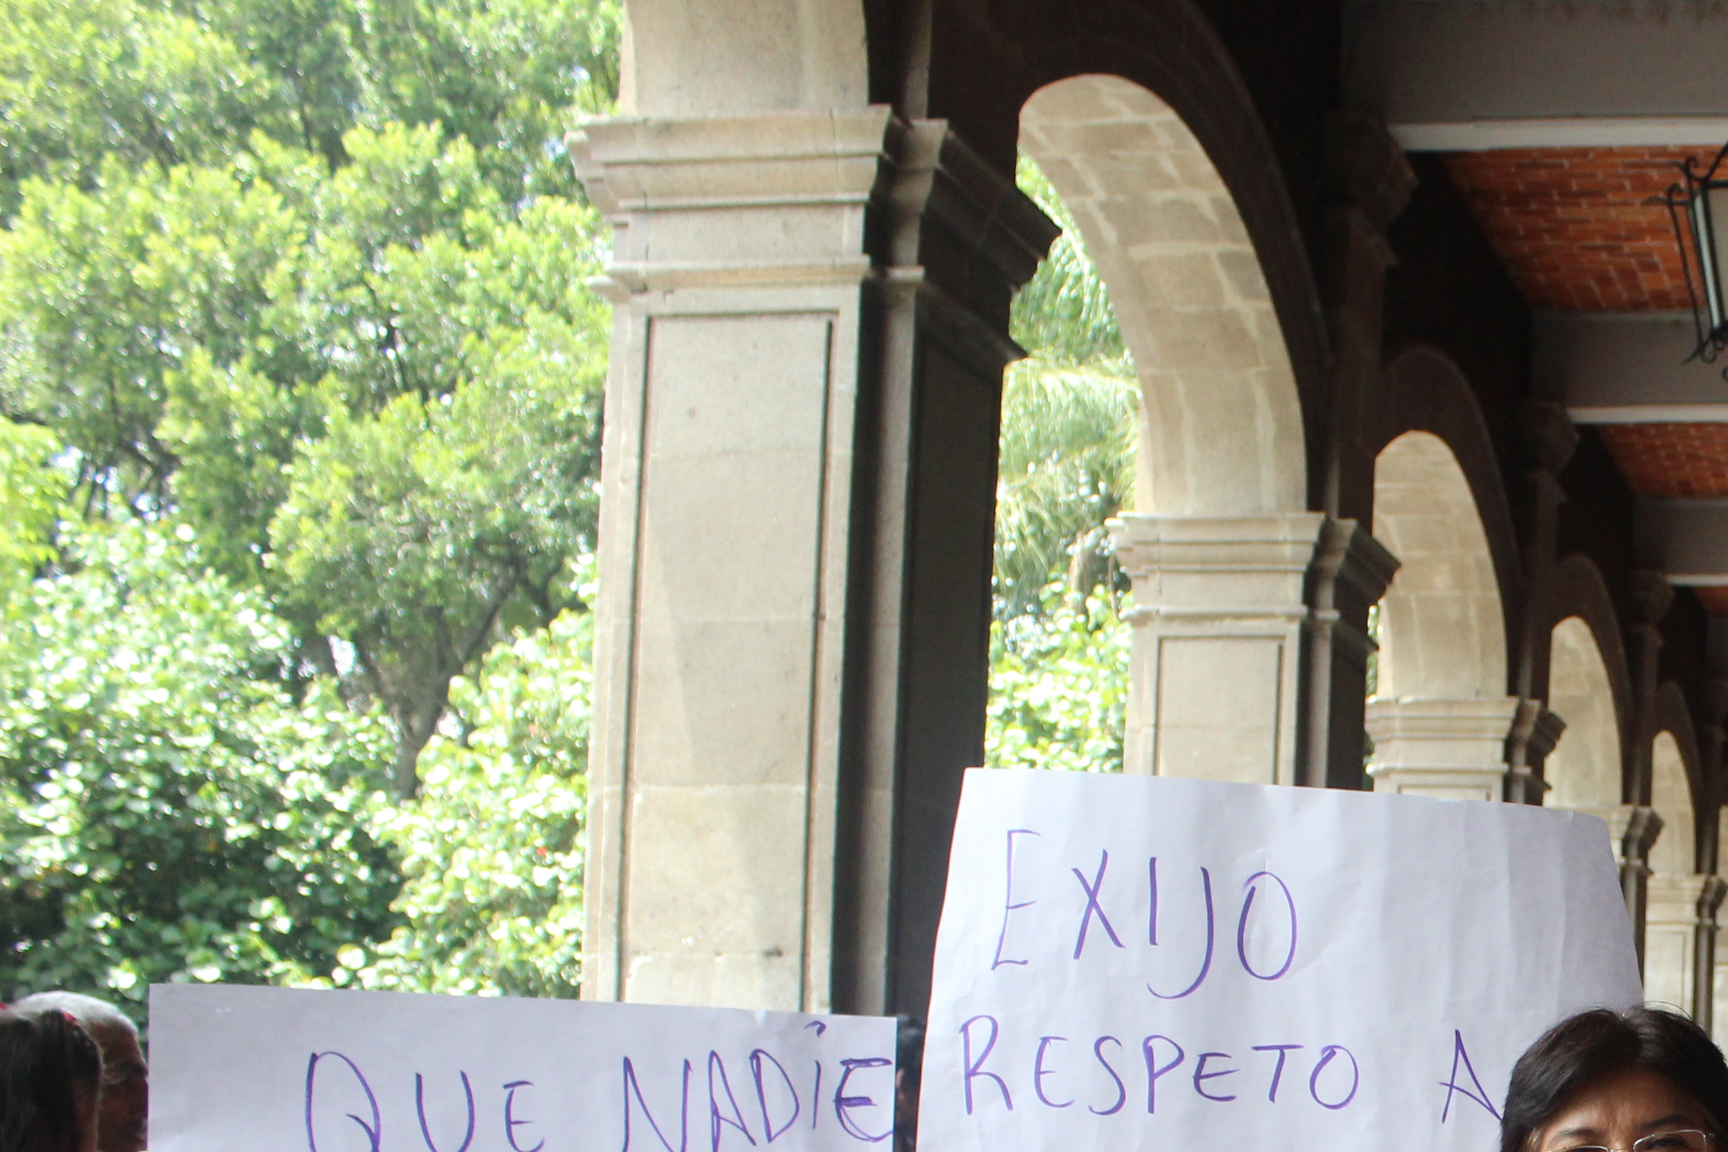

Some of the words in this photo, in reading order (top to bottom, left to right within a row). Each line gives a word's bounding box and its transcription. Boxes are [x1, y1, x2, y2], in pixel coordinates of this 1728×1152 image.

[991, 829, 1298, 999] EXIJO
[959, 1015, 1360, 1116] RESPETO
[1438, 1029, 1503, 1124] A
